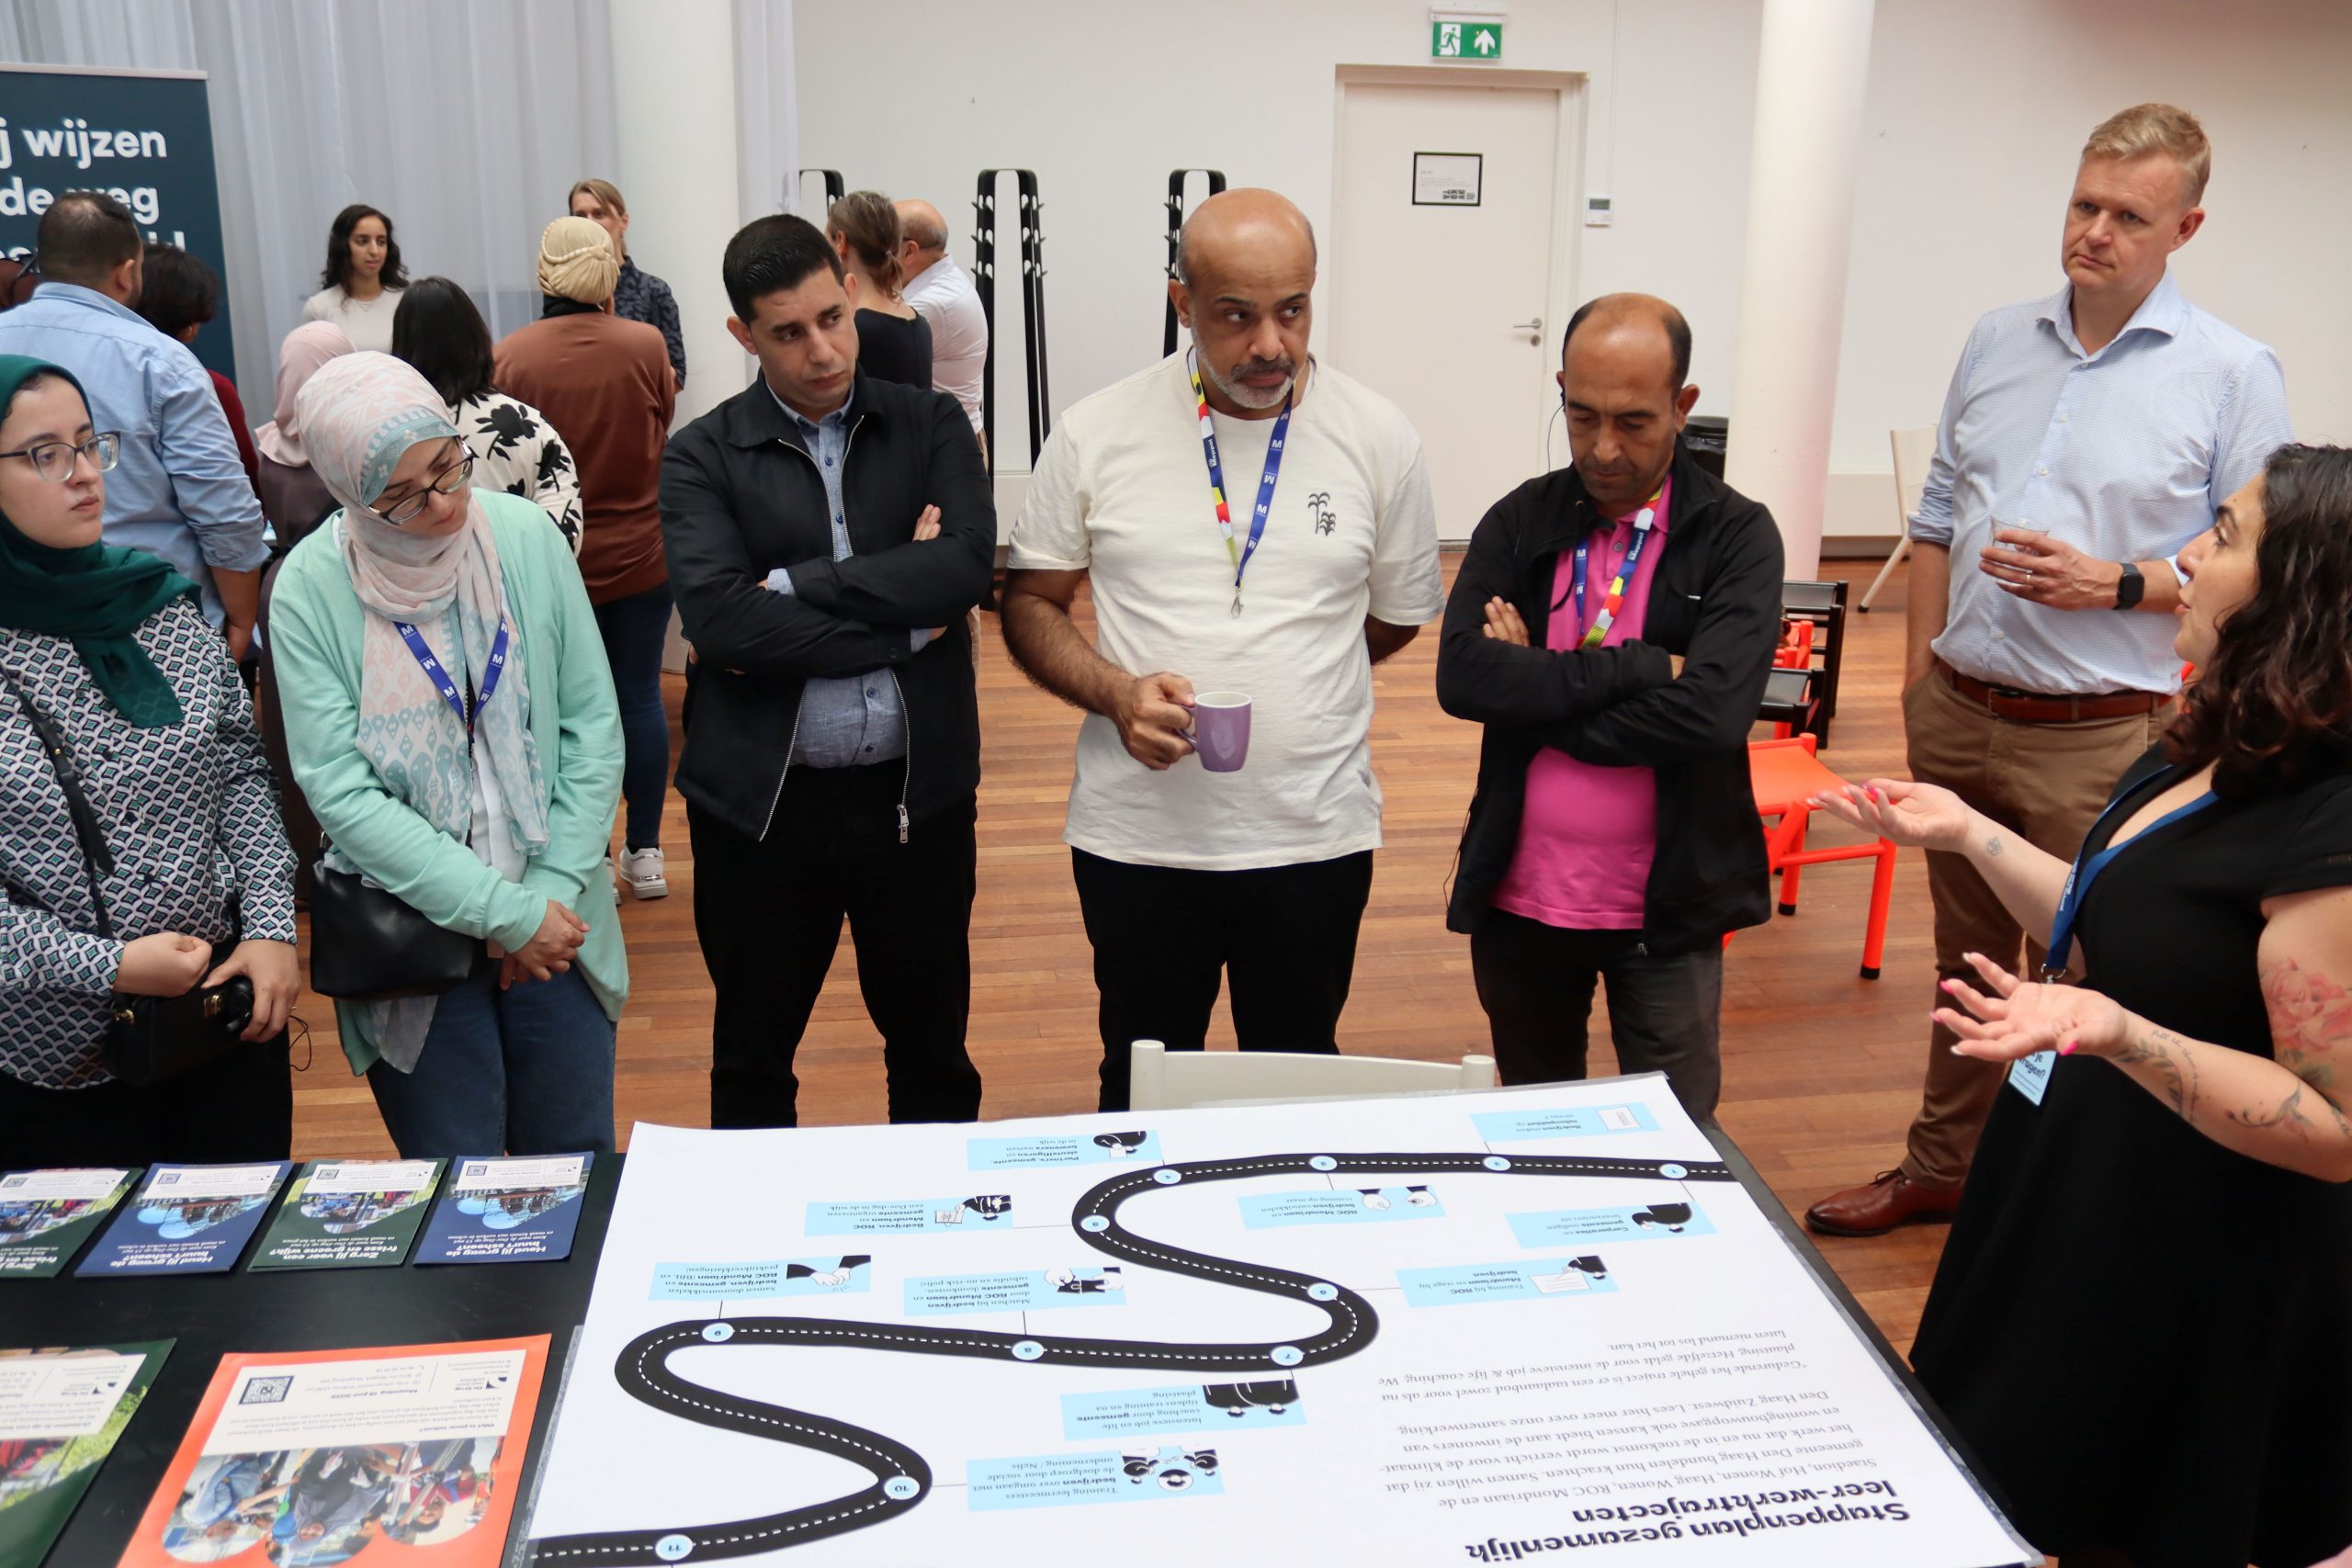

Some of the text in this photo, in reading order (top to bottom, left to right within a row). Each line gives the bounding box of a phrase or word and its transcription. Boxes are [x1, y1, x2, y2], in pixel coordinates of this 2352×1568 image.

[21, 118, 167, 169] wijzen
[0, 176, 159, 225] de eg
[1272, 439, 1283, 448] M
[1257, 503, 1268, 514] M
[401, 625, 413, 636] M
[492, 654, 503, 664] M
[444, 686, 456, 697] M
[1755, 1330, 1786, 1338] laten
[1679, 1338, 1697, 1347] los
[1698, 1334, 1752, 1346] niemand
[1636, 1342, 1657, 1350] het
[1644, 1354, 1674, 1366] geldt
[1678, 1351, 1735, 1363] Hetzelfde
[1531, 1363, 1591, 1373] intensieve
[1596, 1361, 1610, 1371] de
[1711, 1367, 1732, 1375] het
[1468, 1370, 1487, 1381] life
[1506, 1367, 1526, 1378] job
[1626, 1372, 1667, 1382] traject
[1670, 1367, 1708, 1380] gehele
[1379, 1378, 1399, 1386] We
[1572, 1379, 1594, 1387] een
[1456, 1388, 1492, 1398] zowel
[1496, 1382, 1568, 1394] taalaanbod
[1402, 1393, 1420, 1403] als
[1397, 1392, 1829, 1436] Den Haag Zuidwest. Lees hier meer over onze samenwerking.
[1823, 1407, 1840, 1416] en
[1681, 1411, 1820, 1427] woningbouwopgave
[1597, 1427, 1648, 1436] kansen
[1650, 1423, 1678, 1434] ook
[1791, 1427, 1826, 1438] werk
[1829, 1424, 1854, 1433] het
[1556, 1431, 1594, 1442] biedt
[1765, 1431, 1788, 1440] dat
[1433, 1439, 1501, 1450] inwoners
[1505, 1437, 1522, 1447] de
[1613, 1441, 1680, 1453] toekomst
[1683, 1438, 1701, 1449] de
[1505, 1452, 1563, 1465] verricht
[1566, 1448, 1610, 1460] wordt
[1380, 1462, 1443, 1472] klimaat-
[1385, 1439, 1863, 1494] gemeente Den Haag bundelen hun krachten. Samen willen zij dat
[1446, 1461, 1464, 1471] de
[1469, 1458, 1501, 1466] voor
[1440, 1459, 1877, 1509] Staedion, Hof Wonen, Haag Wonen, ROC Mondriaan en de
[1573, 1481, 1896, 1523] leer-werktrajecten
[1465, 1503, 1910, 1562] Stappenplan gezamenlijk
